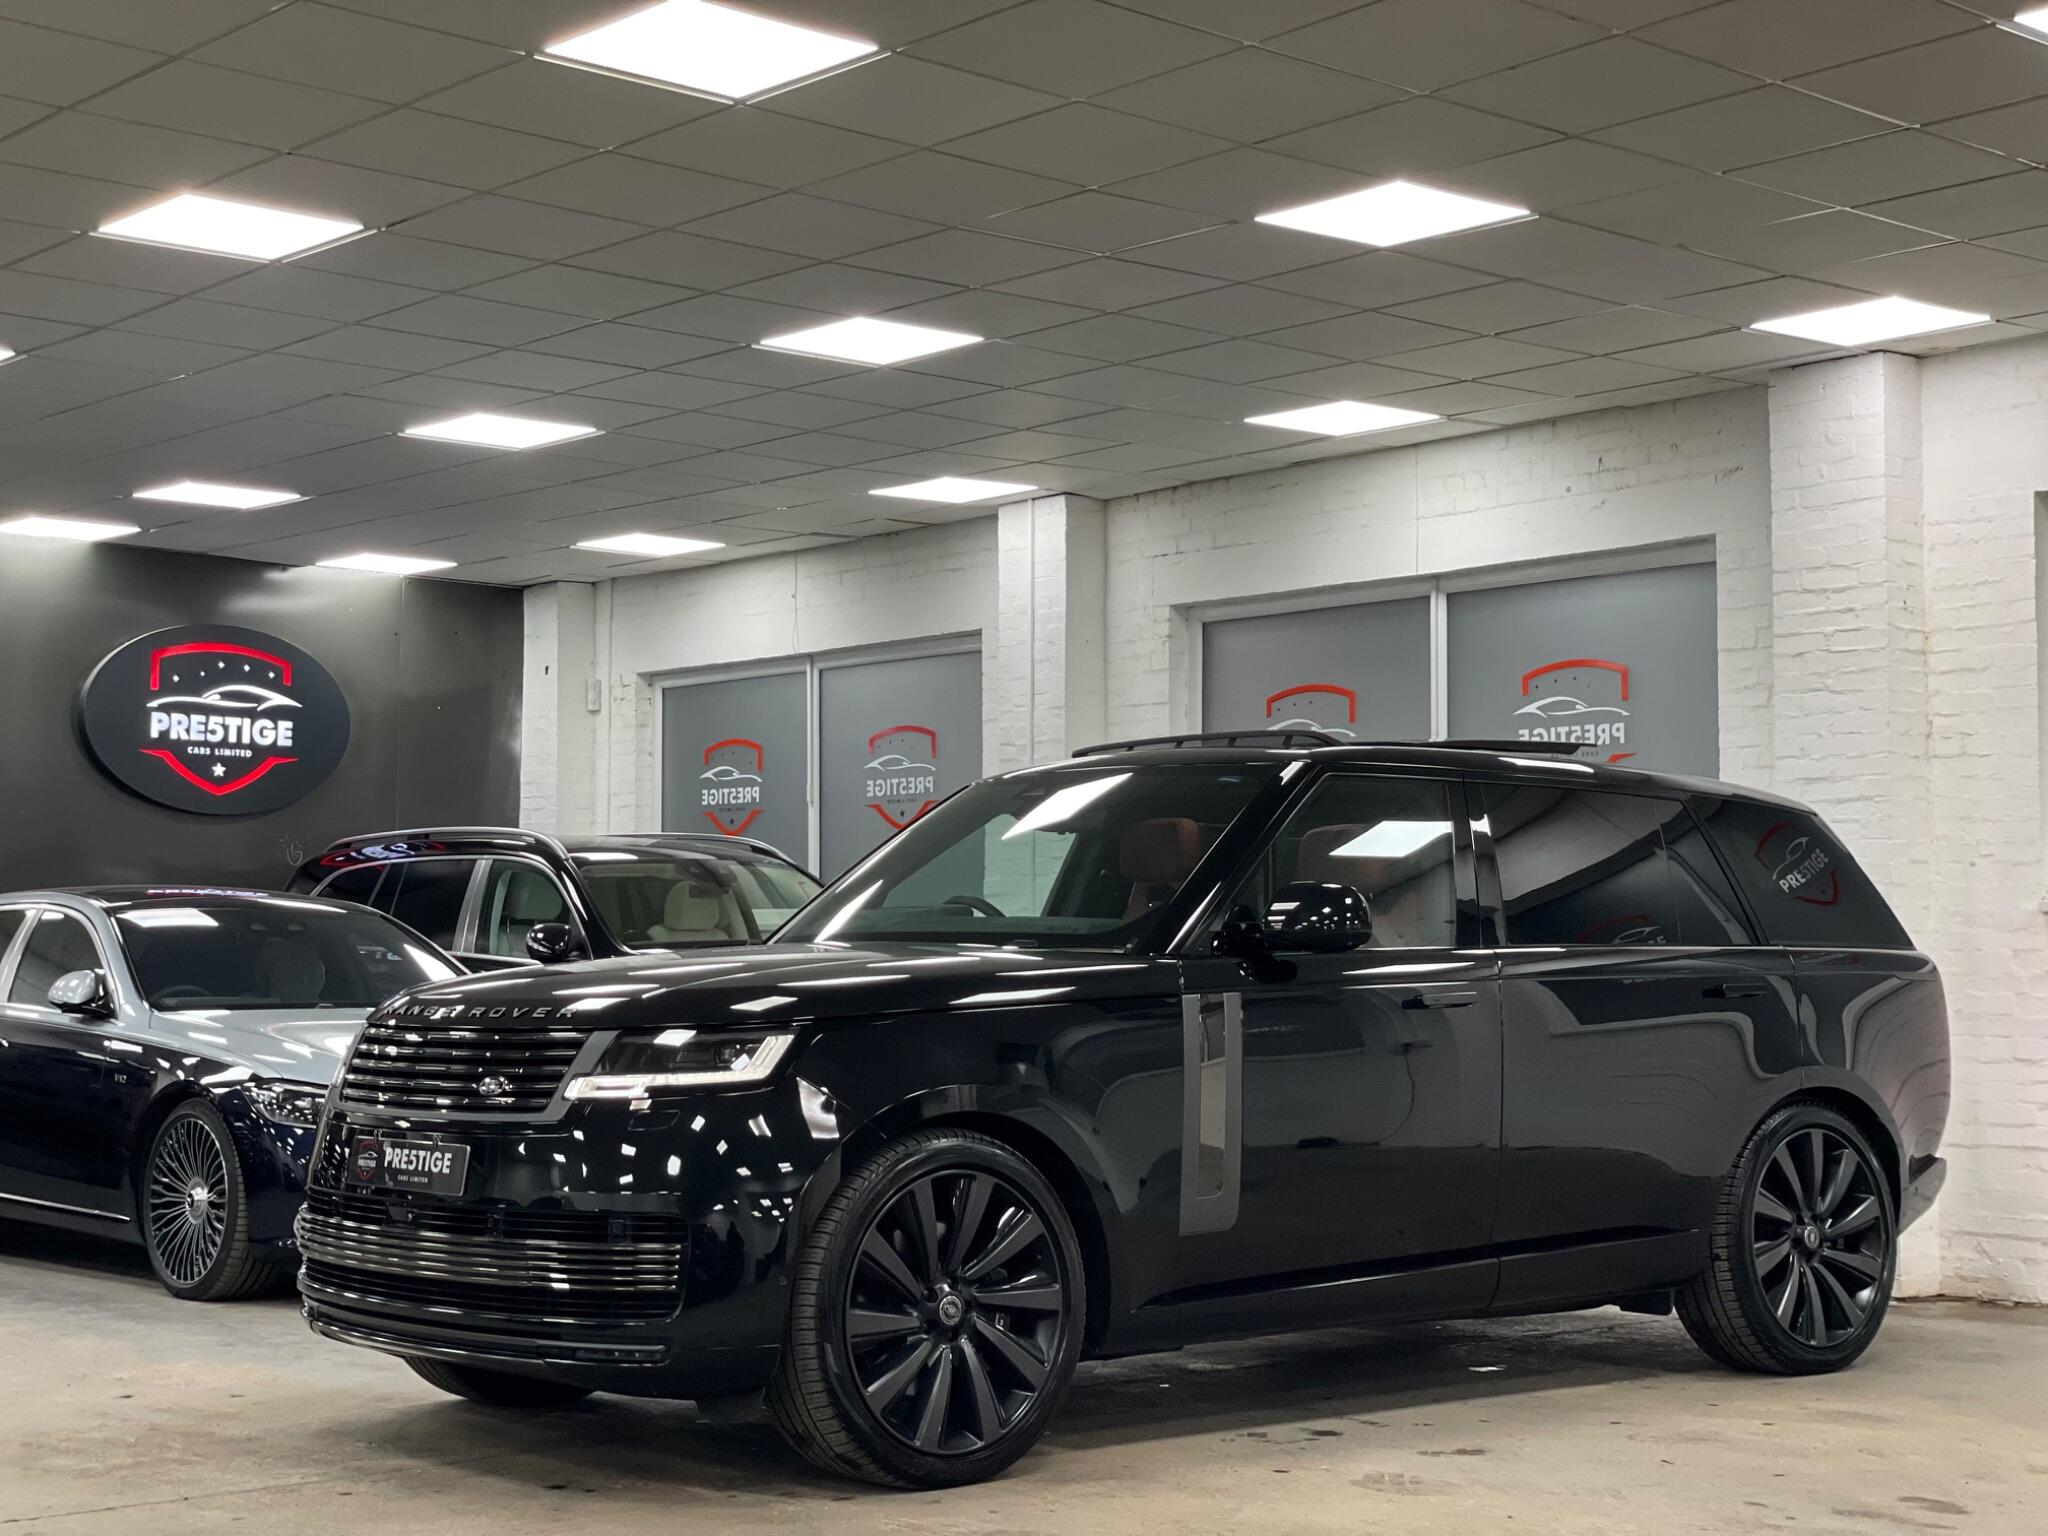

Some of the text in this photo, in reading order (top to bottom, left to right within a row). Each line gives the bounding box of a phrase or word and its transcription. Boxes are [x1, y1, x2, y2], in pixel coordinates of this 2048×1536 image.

[150, 711, 293, 747] PRE5TIGE
[187, 746, 253, 757] CARS LIMITED
[384, 1004, 578, 1018] RANGE ROVER
[384, 1147, 453, 1174] PRE5TIGE
